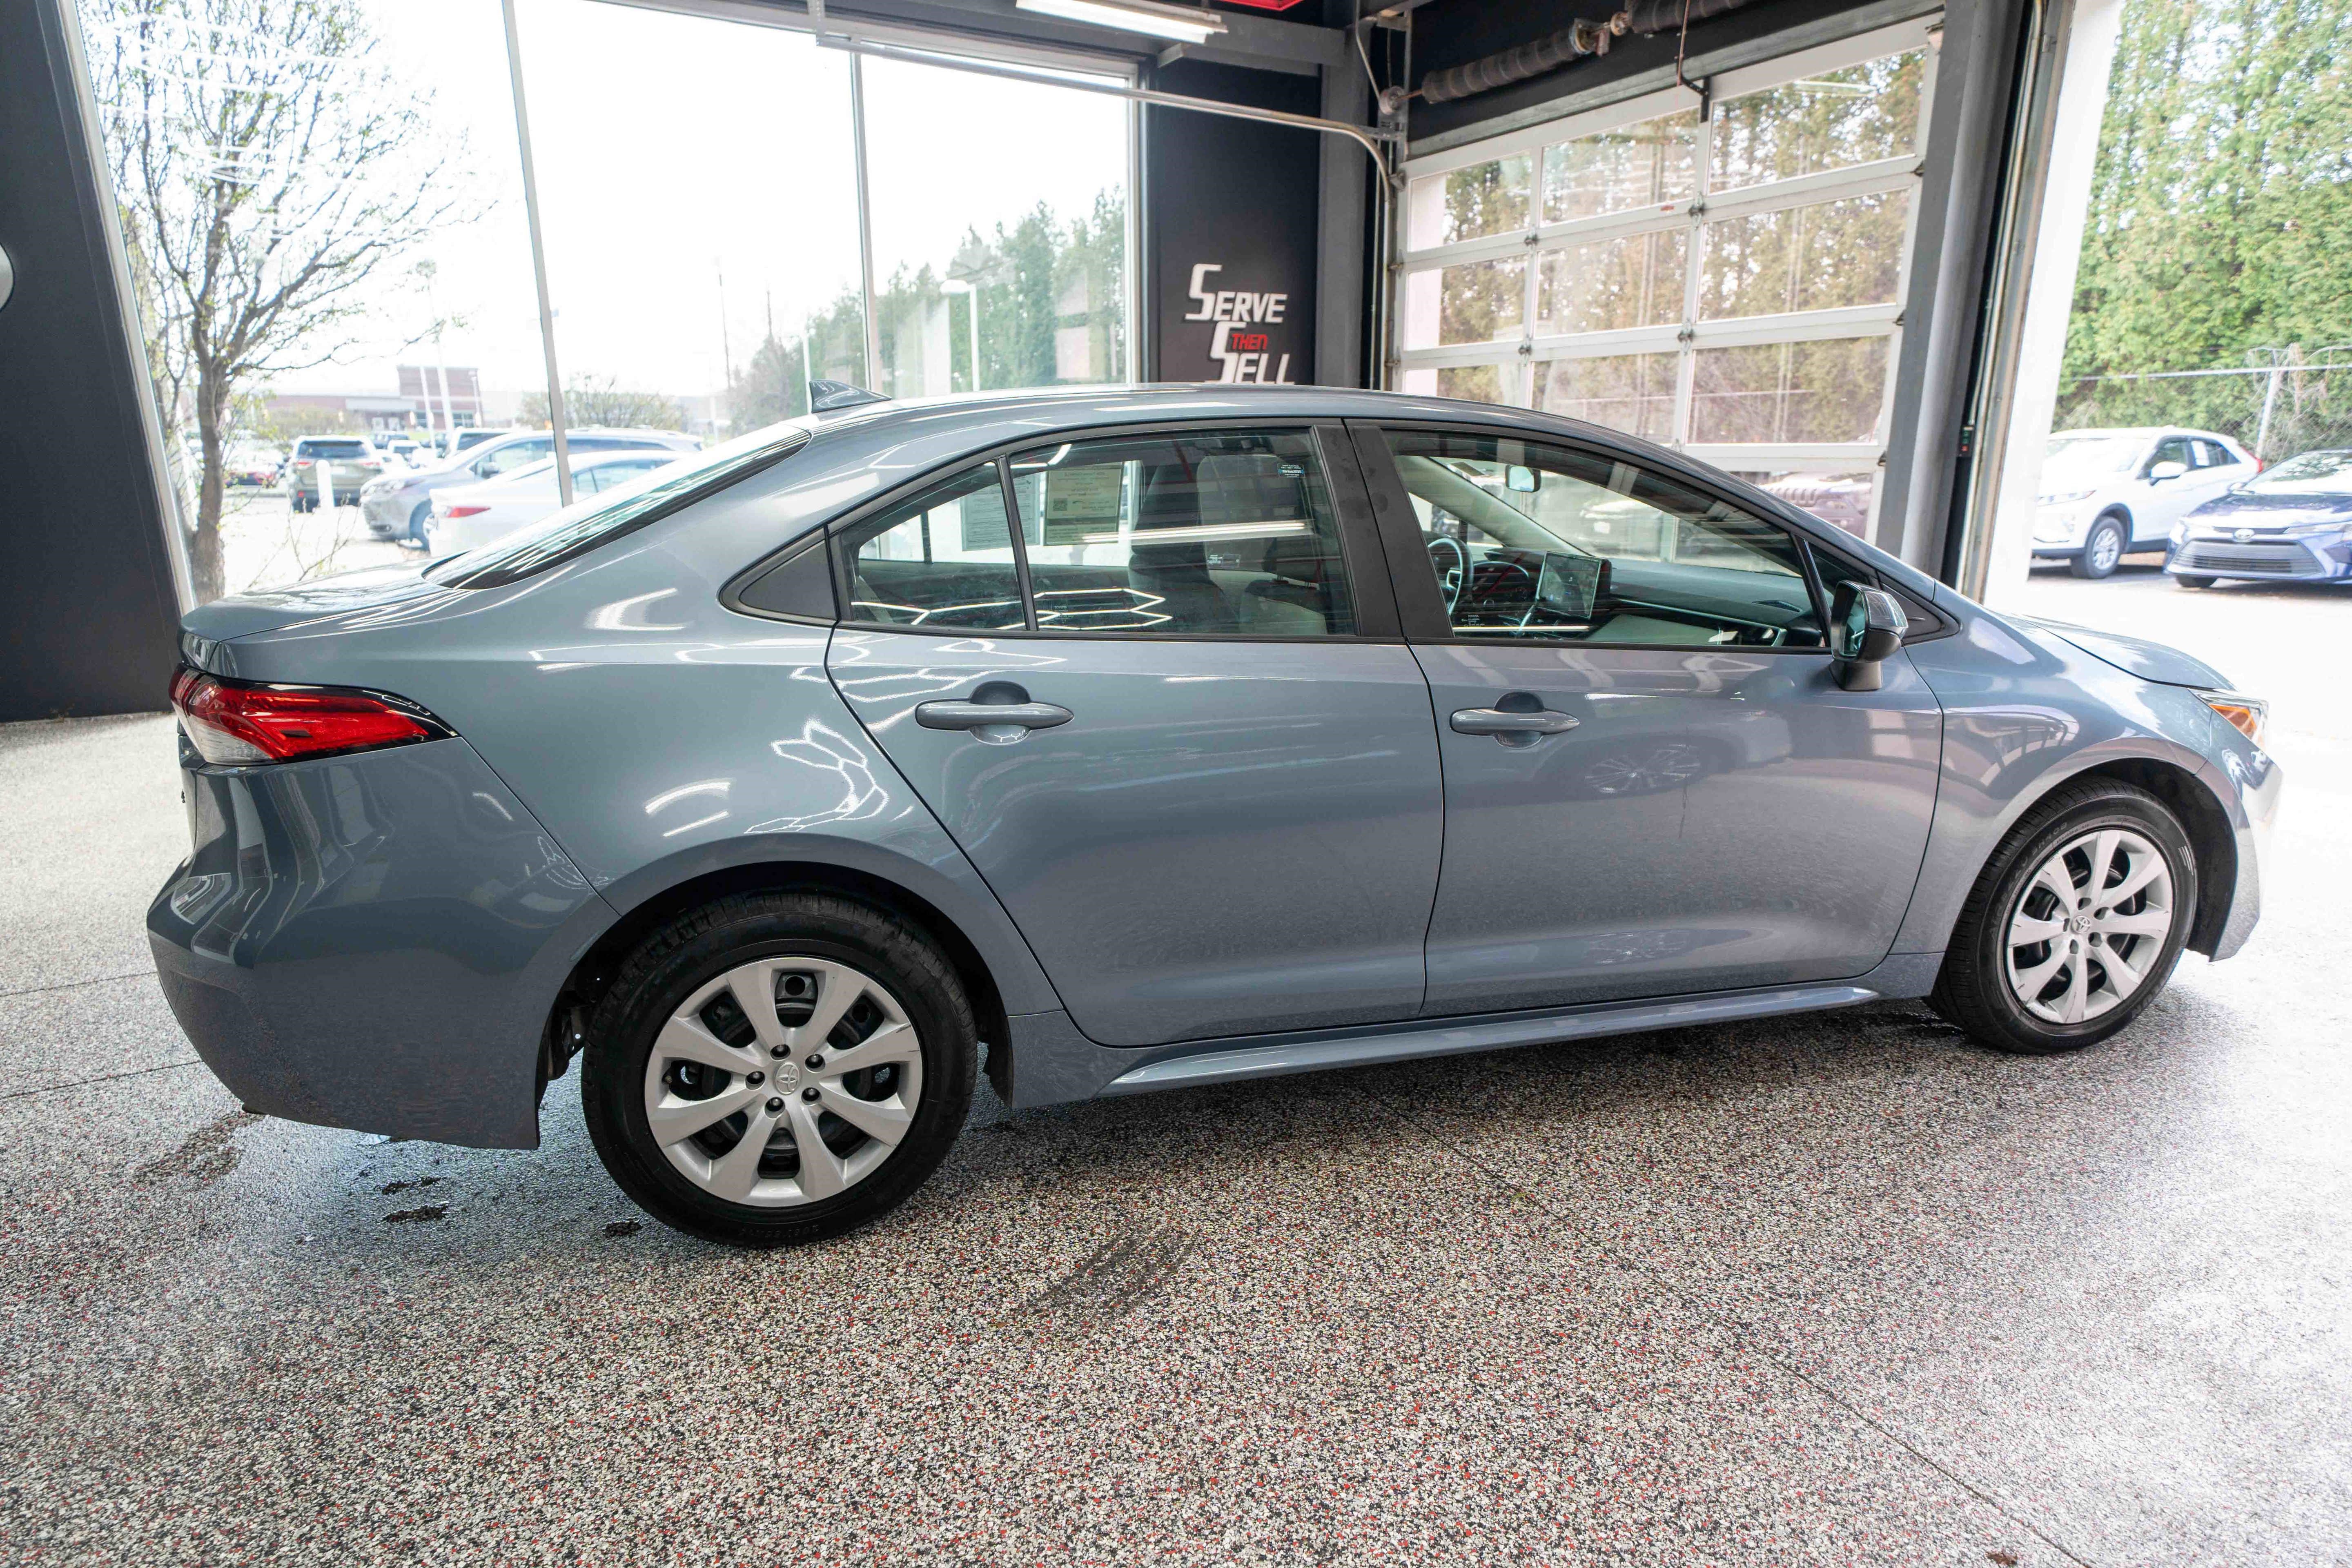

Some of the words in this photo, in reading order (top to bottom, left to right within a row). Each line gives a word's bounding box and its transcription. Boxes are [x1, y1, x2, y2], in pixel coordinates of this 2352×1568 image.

[1185, 263, 1288, 323] SERVE
[1205, 321, 1295, 385] SELL
[1232, 333, 1267, 350] THEN
